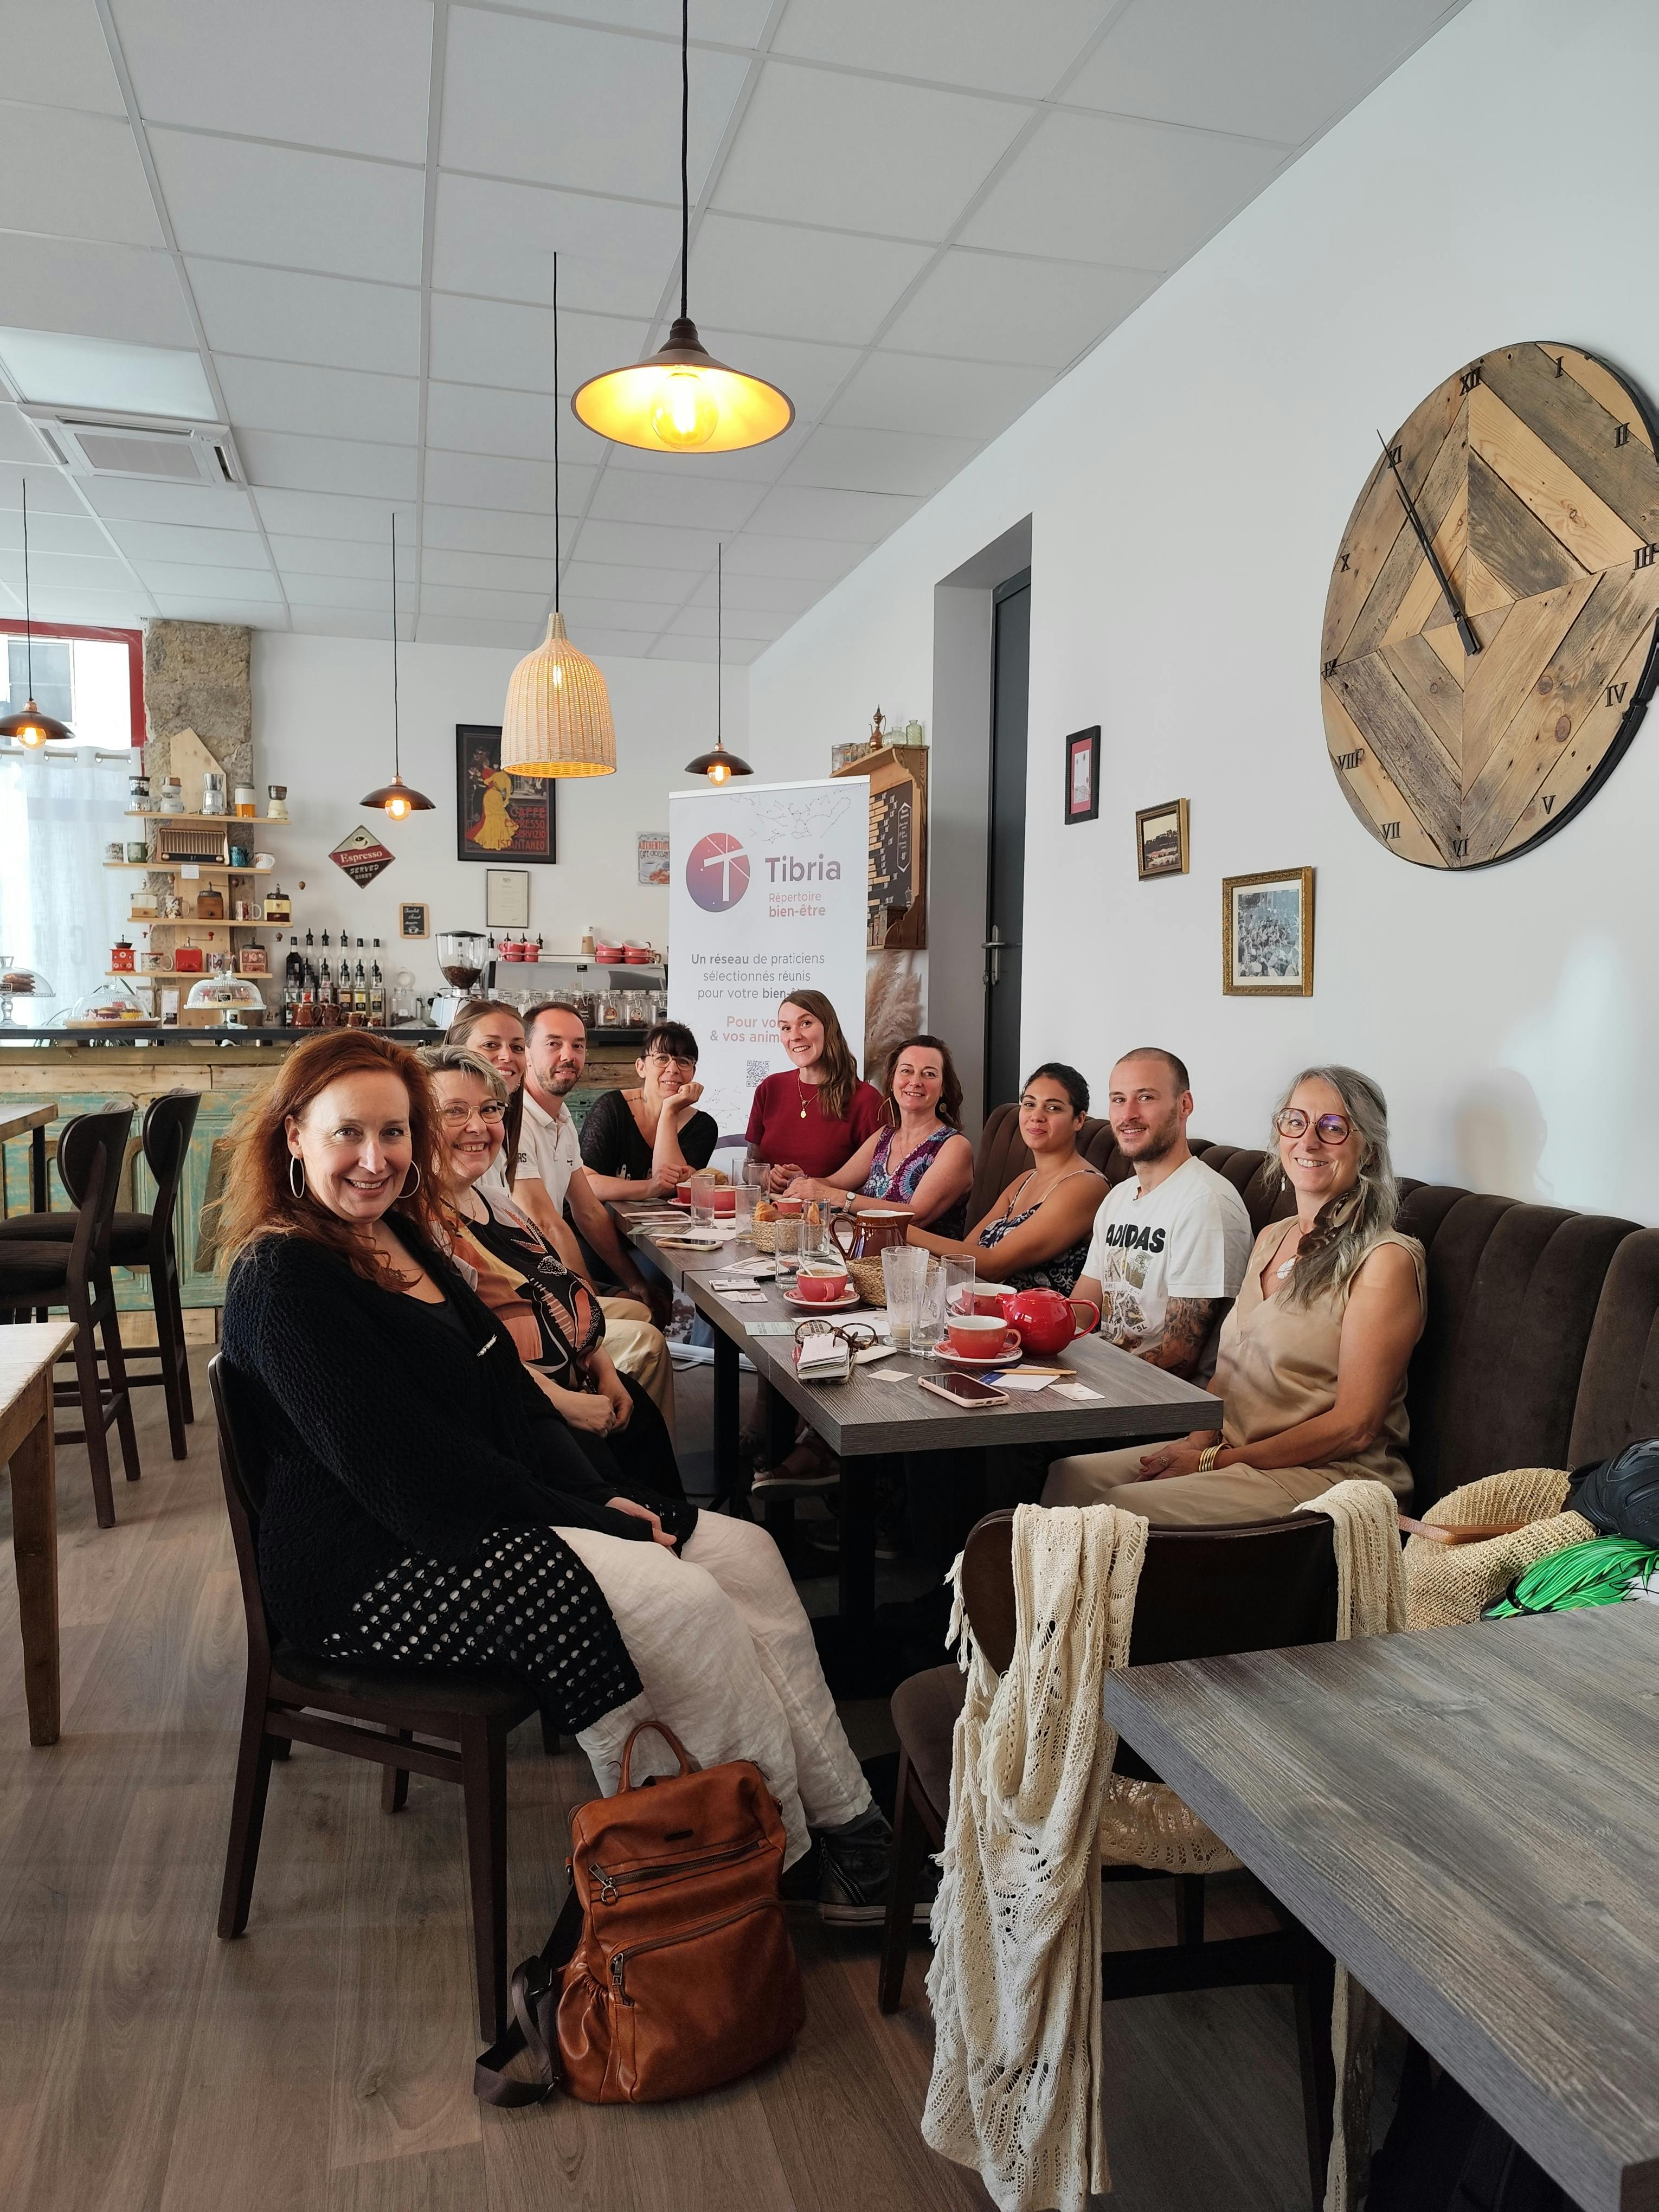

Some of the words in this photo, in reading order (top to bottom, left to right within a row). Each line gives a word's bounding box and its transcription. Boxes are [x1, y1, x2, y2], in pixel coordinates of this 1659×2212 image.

[1459, 366, 1482, 396] XII
[1613, 422, 1630, 448] II
[1340, 553, 1351, 573] X
[1632, 543, 1657, 571] III
[1323, 658, 1338, 678] IX
[1605, 681, 1629, 708] IV
[1336, 751, 1359, 771] VIII
[1541, 795, 1556, 815] V
[505, 819, 545, 829] ESPRESSO
[1380, 821, 1401, 841] VII
[515, 829, 546, 839] SERVIZIO
[498, 839, 545, 851] ISTANTANEO
[1453, 838, 1469, 857] VI
[340, 851, 383, 863] Espresso
[350, 864, 380, 874] SERVED
[765, 853, 841, 883] Tibria
[769, 891, 821, 904] Répertoire
[769, 904, 826, 918] bien-être
[692, 954, 706, 964] Un
[710, 953, 749, 964] réseau
[753, 953, 768, 964] de
[771, 953, 825, 966] praticiens
[703, 970, 775, 982] sélectionnés
[779, 969, 811, 981] réunis
[698, 989, 724, 1000] pour
[728, 988, 758, 999] votre
[726, 1016, 758, 1028] Pour
[710, 1030, 718, 1041] &
[723, 1032, 745, 1042] vos
[1105, 1223, 1166, 1253] ADIDAS
